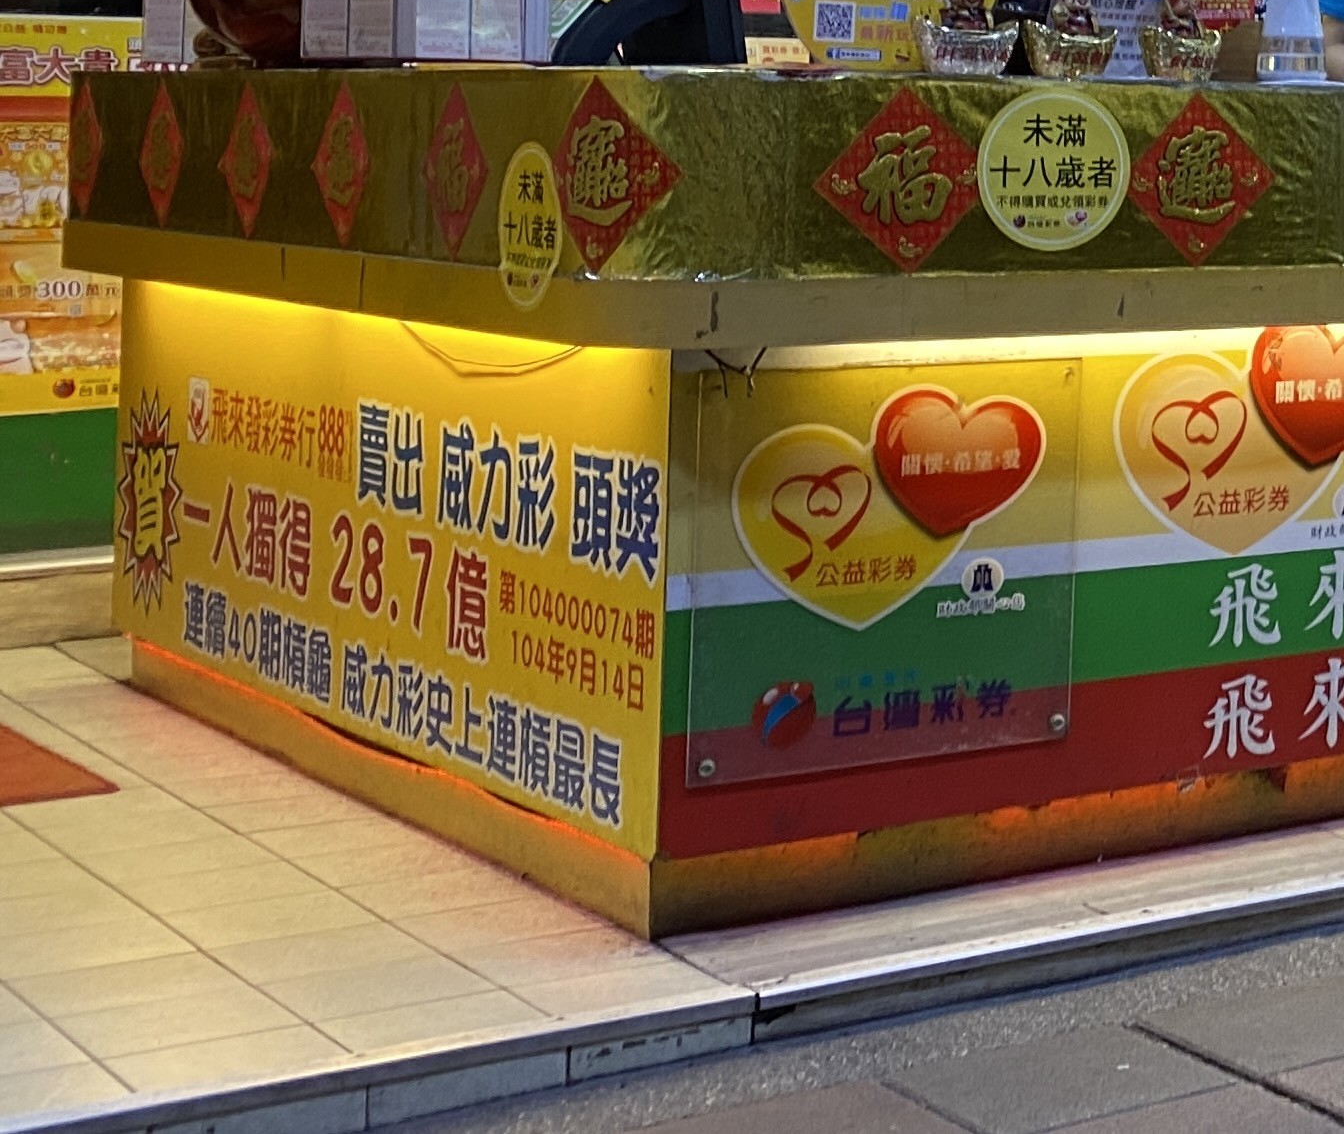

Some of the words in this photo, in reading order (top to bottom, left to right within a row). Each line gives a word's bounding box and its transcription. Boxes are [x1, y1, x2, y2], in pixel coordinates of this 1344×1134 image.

[1023, 113, 1087, 148] 未滿
[517, 171, 546, 205] 未滿
[990, 156, 1117, 189] 十八歲者
[503, 212, 558, 251] 十八歲者
[211, 387, 316, 470] 飛來發彩券行
[358, 403, 424, 516] 賣出
[439, 423, 556, 550] 威力彩
[570, 451, 661, 580] 頭獎
[1192, 484, 1292, 520] 公益彩券
[182, 485, 313, 598] 一人獨得
[815, 556, 918, 588] 公益彩券
[500, 569, 656, 659] 第104000074期
[510, 629, 646, 711] 104年9月14日
[183, 581, 333, 705] 連續40期槓龜
[340, 643, 622, 827] 威力彩史上連槓最長
